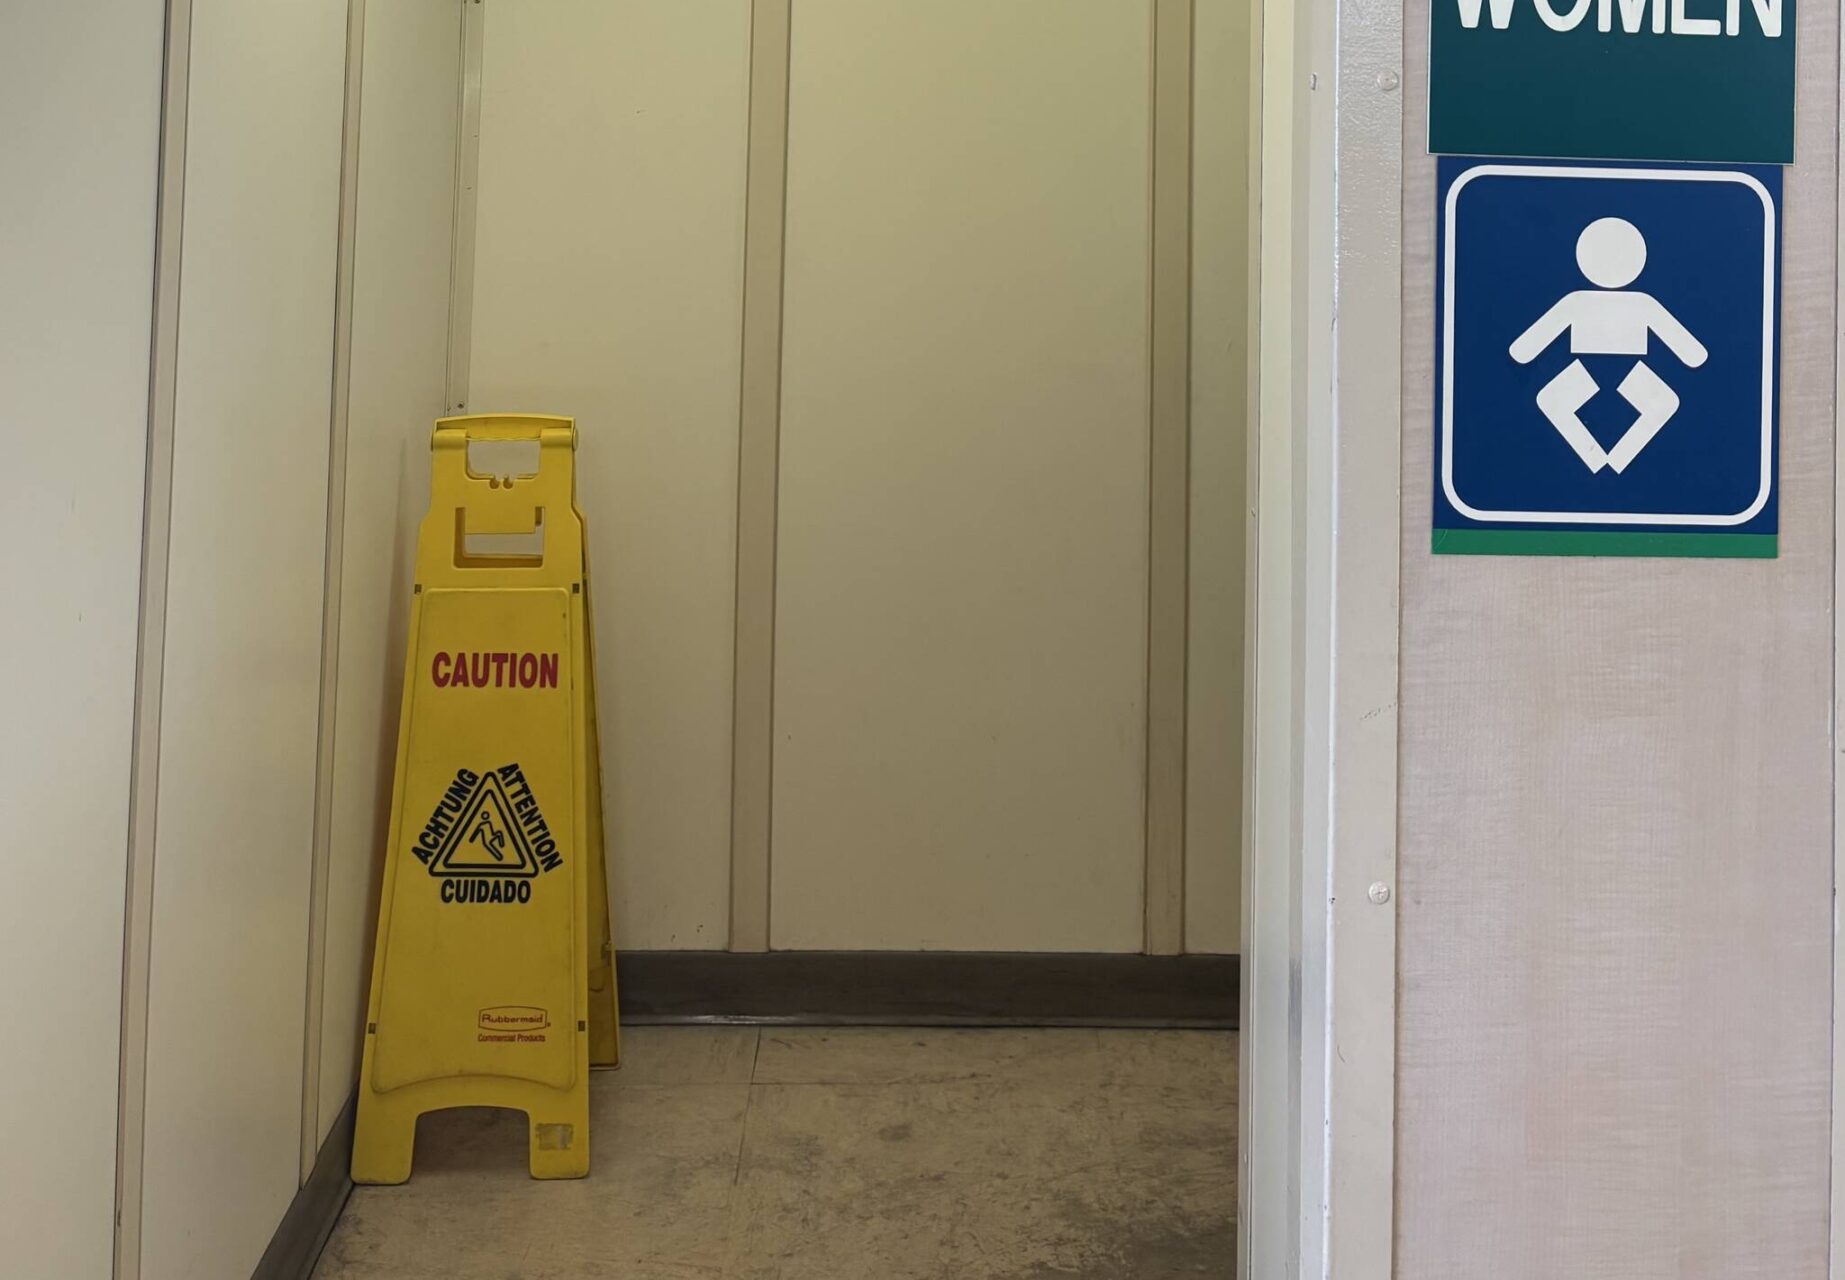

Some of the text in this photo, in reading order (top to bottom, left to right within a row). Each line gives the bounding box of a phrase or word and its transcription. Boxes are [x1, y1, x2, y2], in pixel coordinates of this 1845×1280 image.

[432, 652, 558, 688] CAUTION
[411, 768, 479, 864] ACHTUNG
[497, 763, 564, 873] ATTENTION
[441, 879, 531, 904] CUIDADO
[482, 1014, 543, 1023] Rubbermaid
[479, 1034, 545, 1042] Commercial Products
